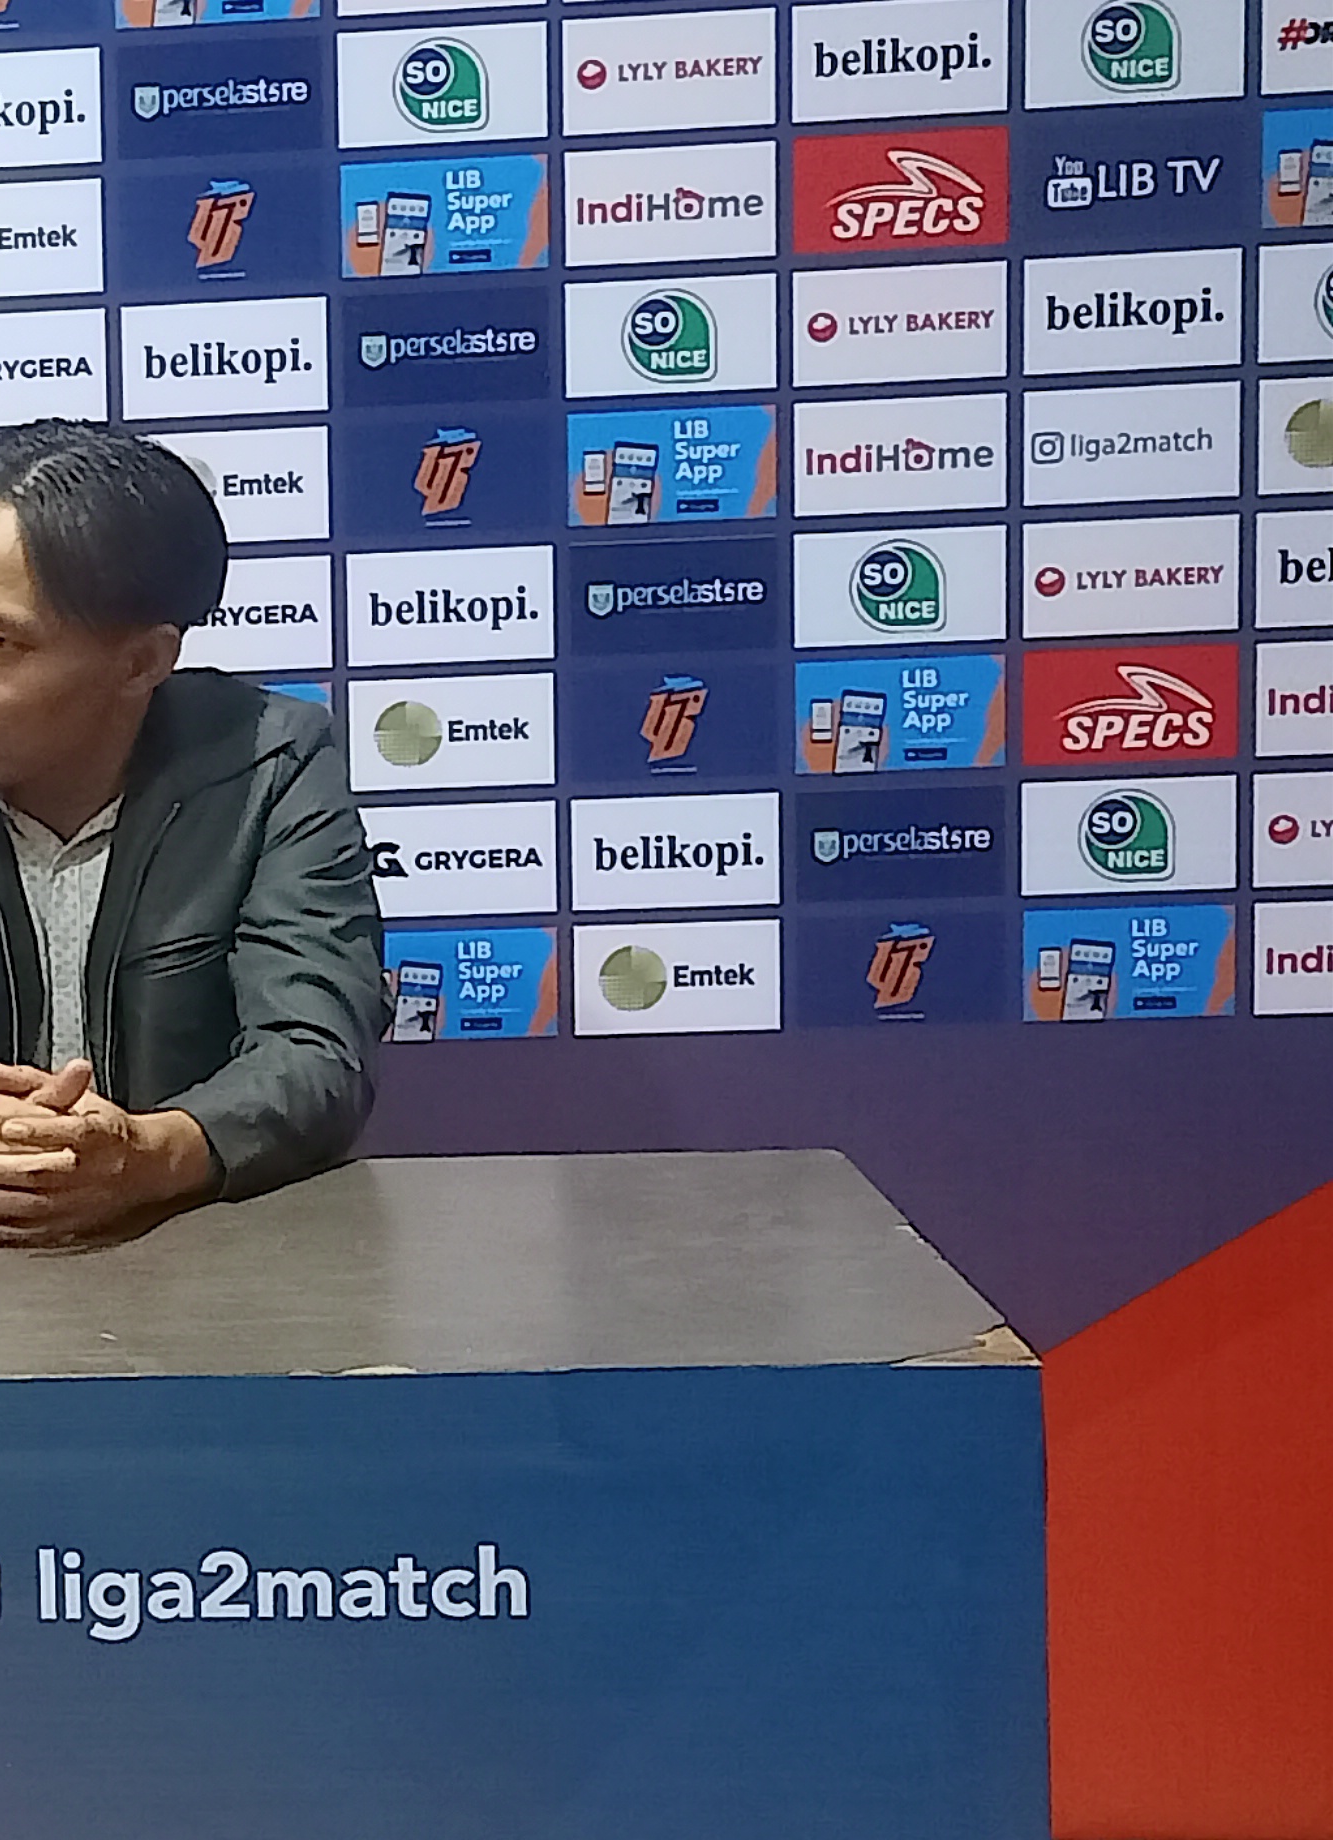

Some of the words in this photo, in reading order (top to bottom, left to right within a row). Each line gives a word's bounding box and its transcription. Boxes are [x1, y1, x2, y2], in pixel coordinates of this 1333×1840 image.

[1096, 19, 1137, 42] SO
[814, 33, 991, 80] belikopi.
[1111, 57, 1169, 78] NICE
[407, 60, 446, 83] SO
[618, 61, 667, 82] LYLY
[675, 56, 762, 79] BAKERY
[422, 99, 477, 118] NICE
[446, 170, 480, 189] LIB
[1098, 163, 1154, 197] LIB
[1167, 158, 1219, 193] TV
[448, 192, 512, 213] Super
[577, 188, 763, 225] IndiHome
[448, 212, 495, 234] App
[833, 197, 983, 238] SPECS
[635, 312, 676, 334] SO
[849, 314, 898, 335] LYLY
[906, 310, 994, 332] BAKERY
[1046, 292, 1224, 334] belikopi.
[144, 338, 312, 383] belikopi.
[651, 349, 707, 369] NICE
[674, 420, 708, 439] LIB
[675, 442, 740, 463] Super
[1071, 427, 1212, 462] liga2match
[806, 438, 994, 475] IndiHome
[223, 471, 303, 496] Emtek
[675, 462, 722, 484] App
[864, 563, 904, 585] SO
[1077, 570, 1127, 590] LYLY
[1135, 565, 1224, 587] BAKERY
[369, 586, 538, 630] belikopi.
[879, 601, 935, 619] NICE
[903, 669, 937, 687] LIB
[903, 691, 969, 712] Super
[448, 718, 529, 742] Emtek
[903, 711, 951, 733] App
[1063, 711, 1212, 750] SPECS
[1092, 811, 1133, 833] SO
[415, 848, 542, 870] GRYGERA
[594, 833, 763, 876] belikopi.
[1108, 849, 1164, 868] NICE
[1132, 919, 1167, 936] LIB
[458, 941, 491, 959] LIB
[1132, 940, 1199, 961] Super
[459, 962, 522, 983] Super
[674, 963, 754, 987] Emtek
[1132, 960, 1180, 981] App
[459, 982, 505, 1002] App
[35, 1544, 531, 1643] liga2match
